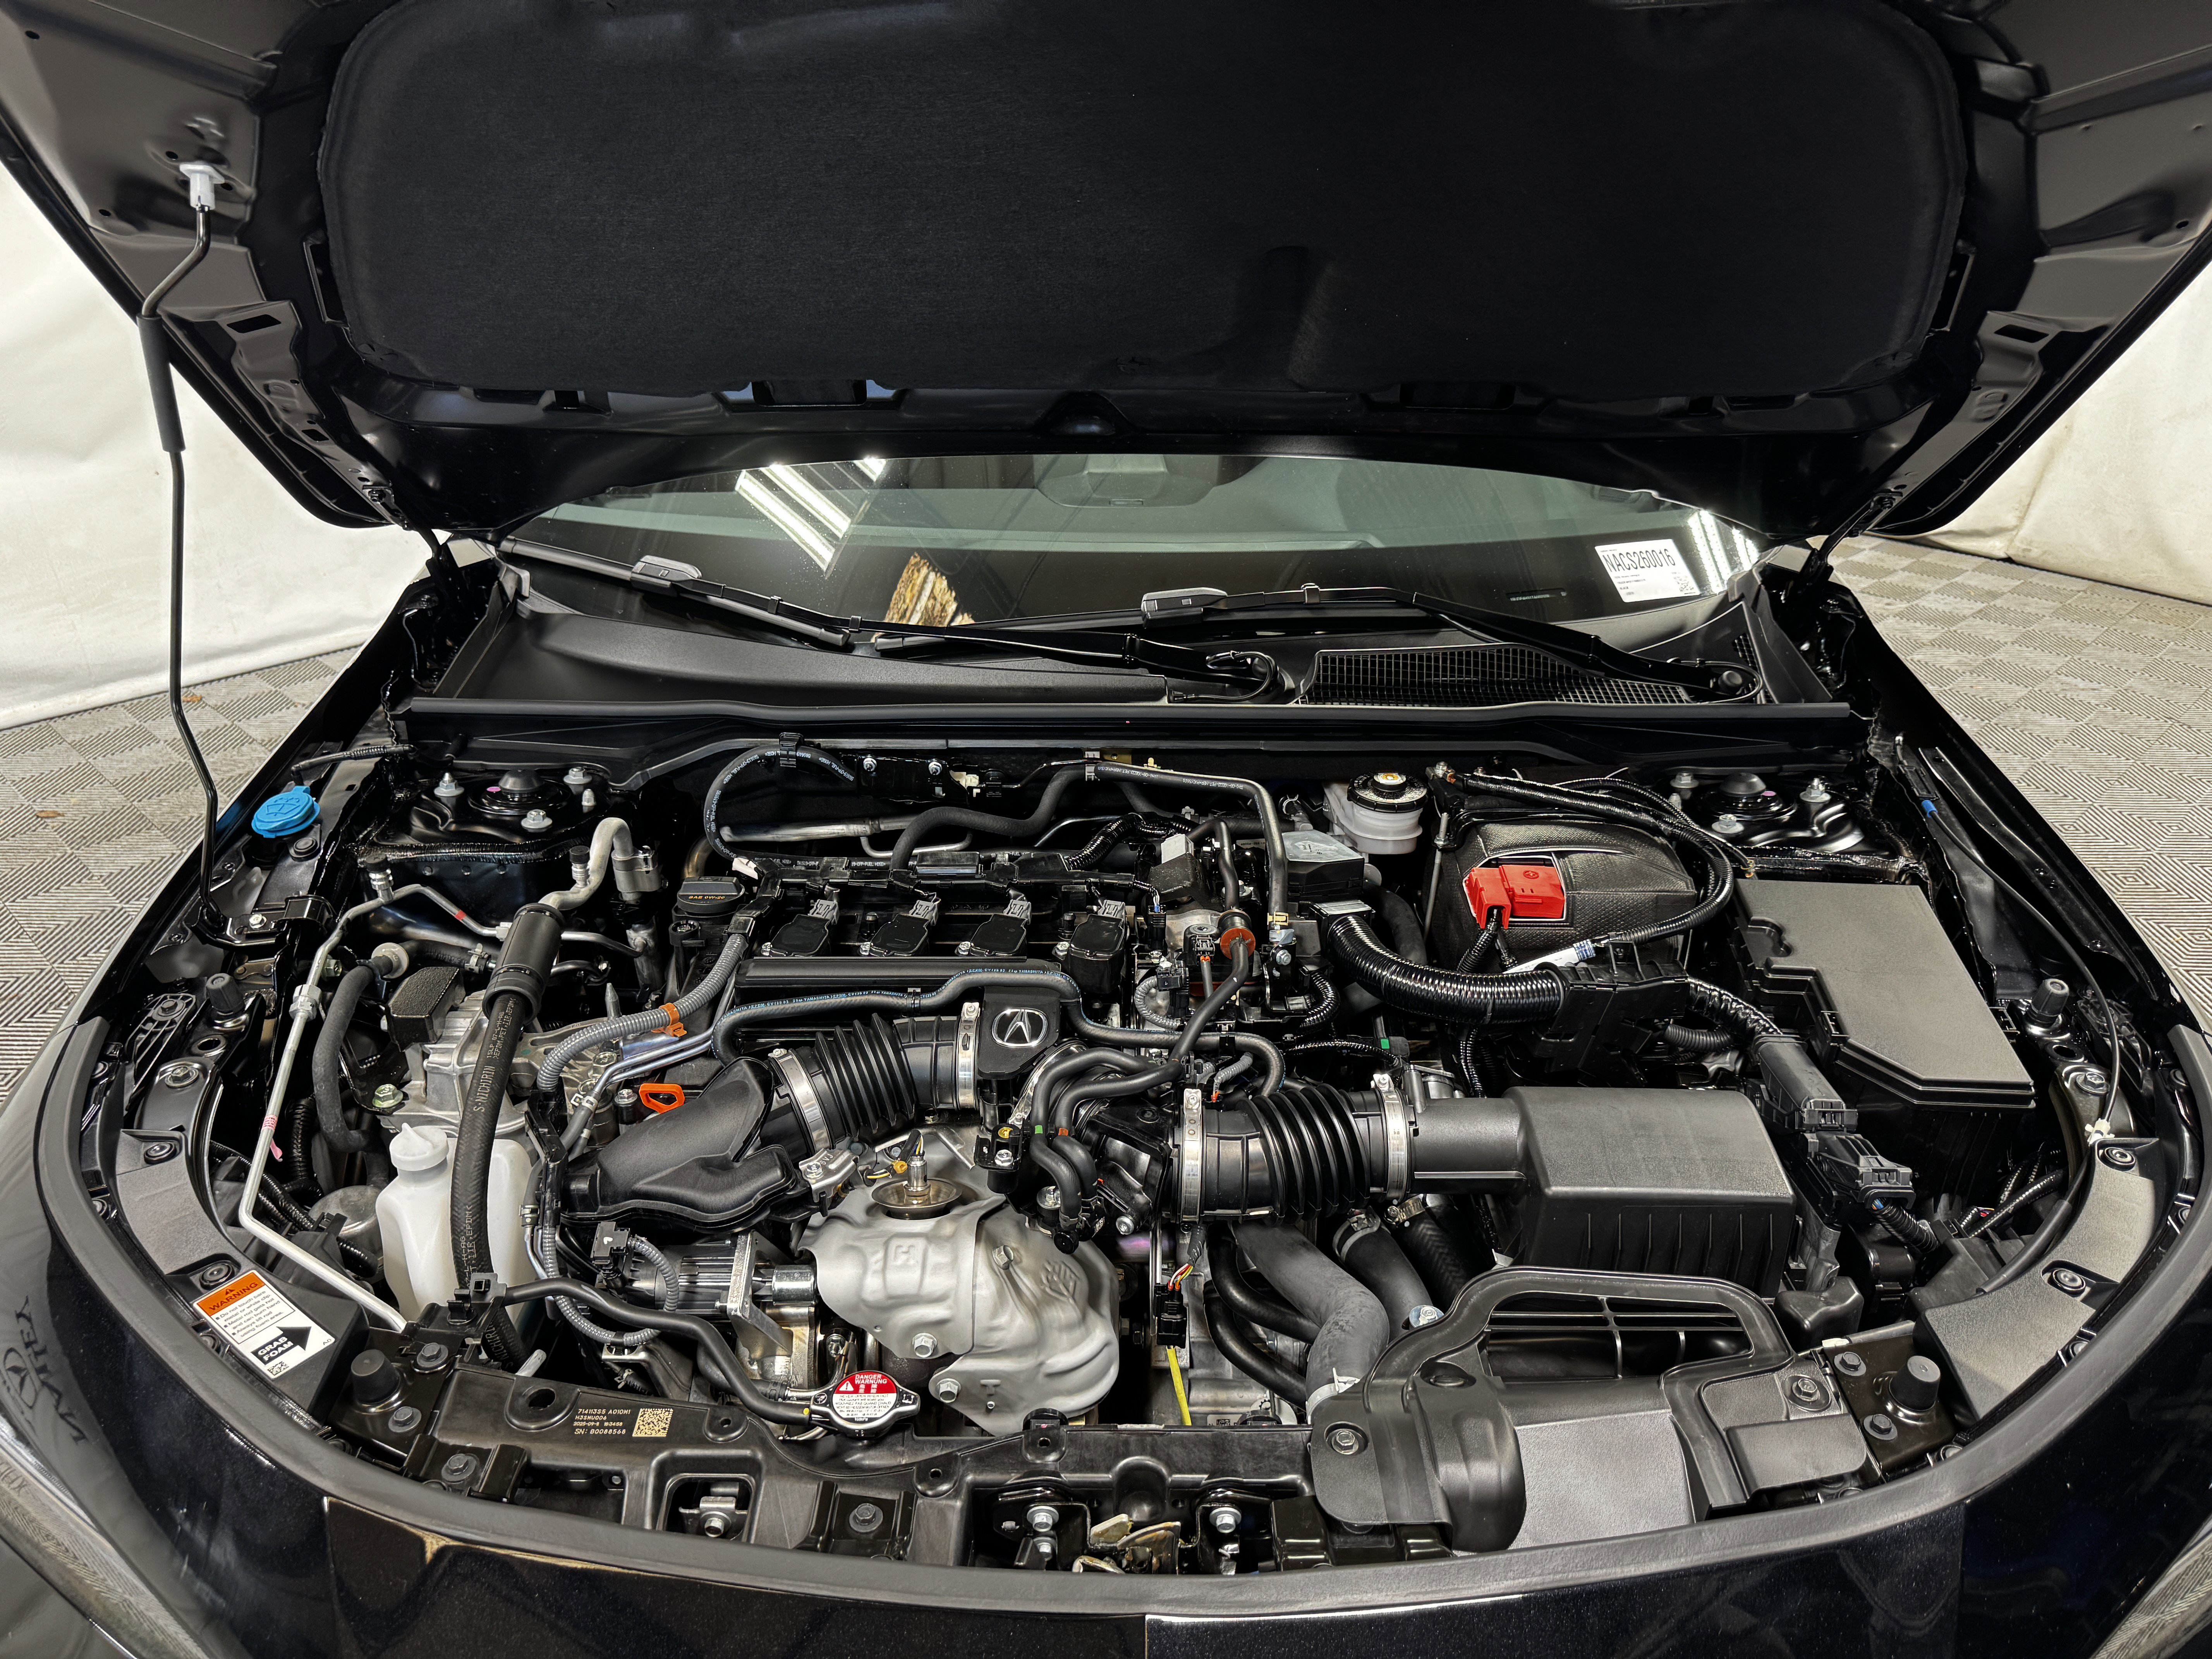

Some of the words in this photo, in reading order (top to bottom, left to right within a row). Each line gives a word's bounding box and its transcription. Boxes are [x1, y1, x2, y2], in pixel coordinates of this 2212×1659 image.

[1602, 548, 1675, 572] NACS260016
[209, 1283, 258, 1310] WARNING
[258, 1336, 288, 1355] GRAB
[263, 1341, 294, 1362] FOAM
